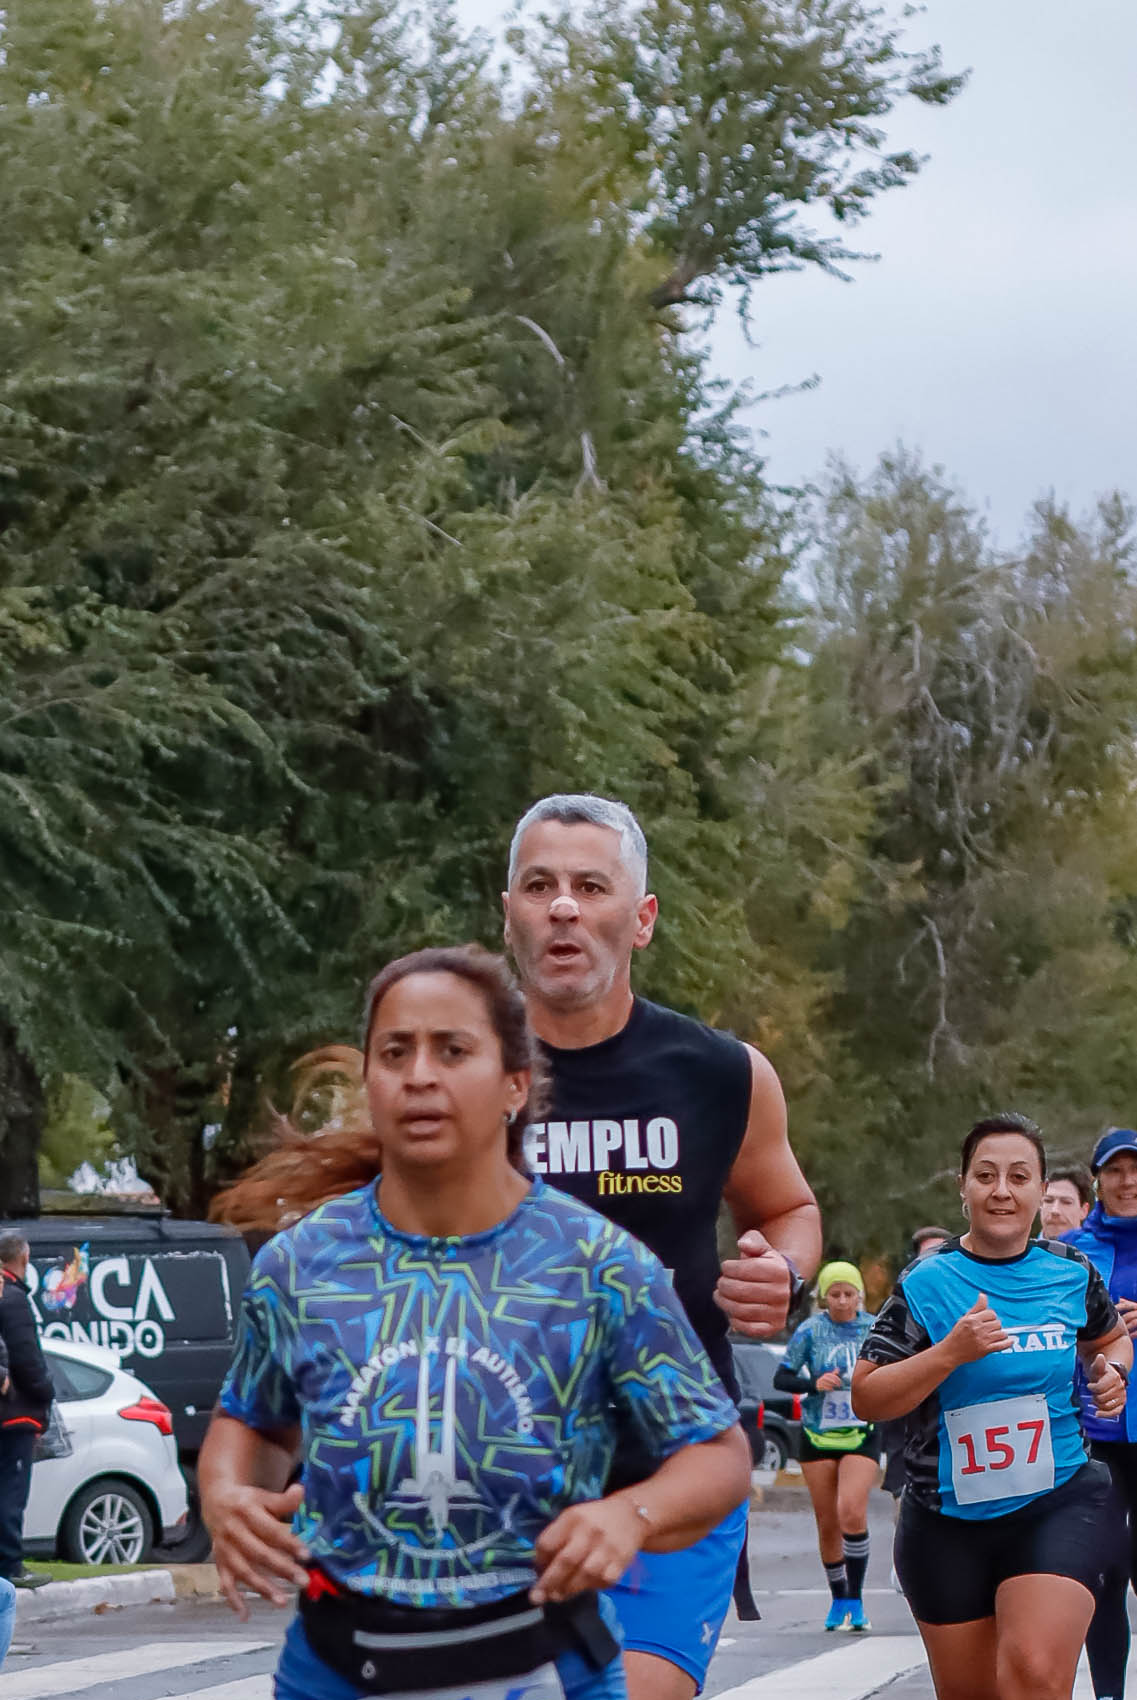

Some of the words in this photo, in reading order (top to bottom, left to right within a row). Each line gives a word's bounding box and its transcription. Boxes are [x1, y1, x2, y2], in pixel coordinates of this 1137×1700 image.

[523, 1117, 679, 1173] EMPLO
[598, 1171, 683, 1195] fitness
[37, 1319, 164, 1359] ONIDO
[992, 1332, 1070, 1354] RAIL
[470, 1346, 535, 1434] AUTISMO
[824, 1401, 858, 1421] 33
[957, 1419, 1045, 1475] 157
